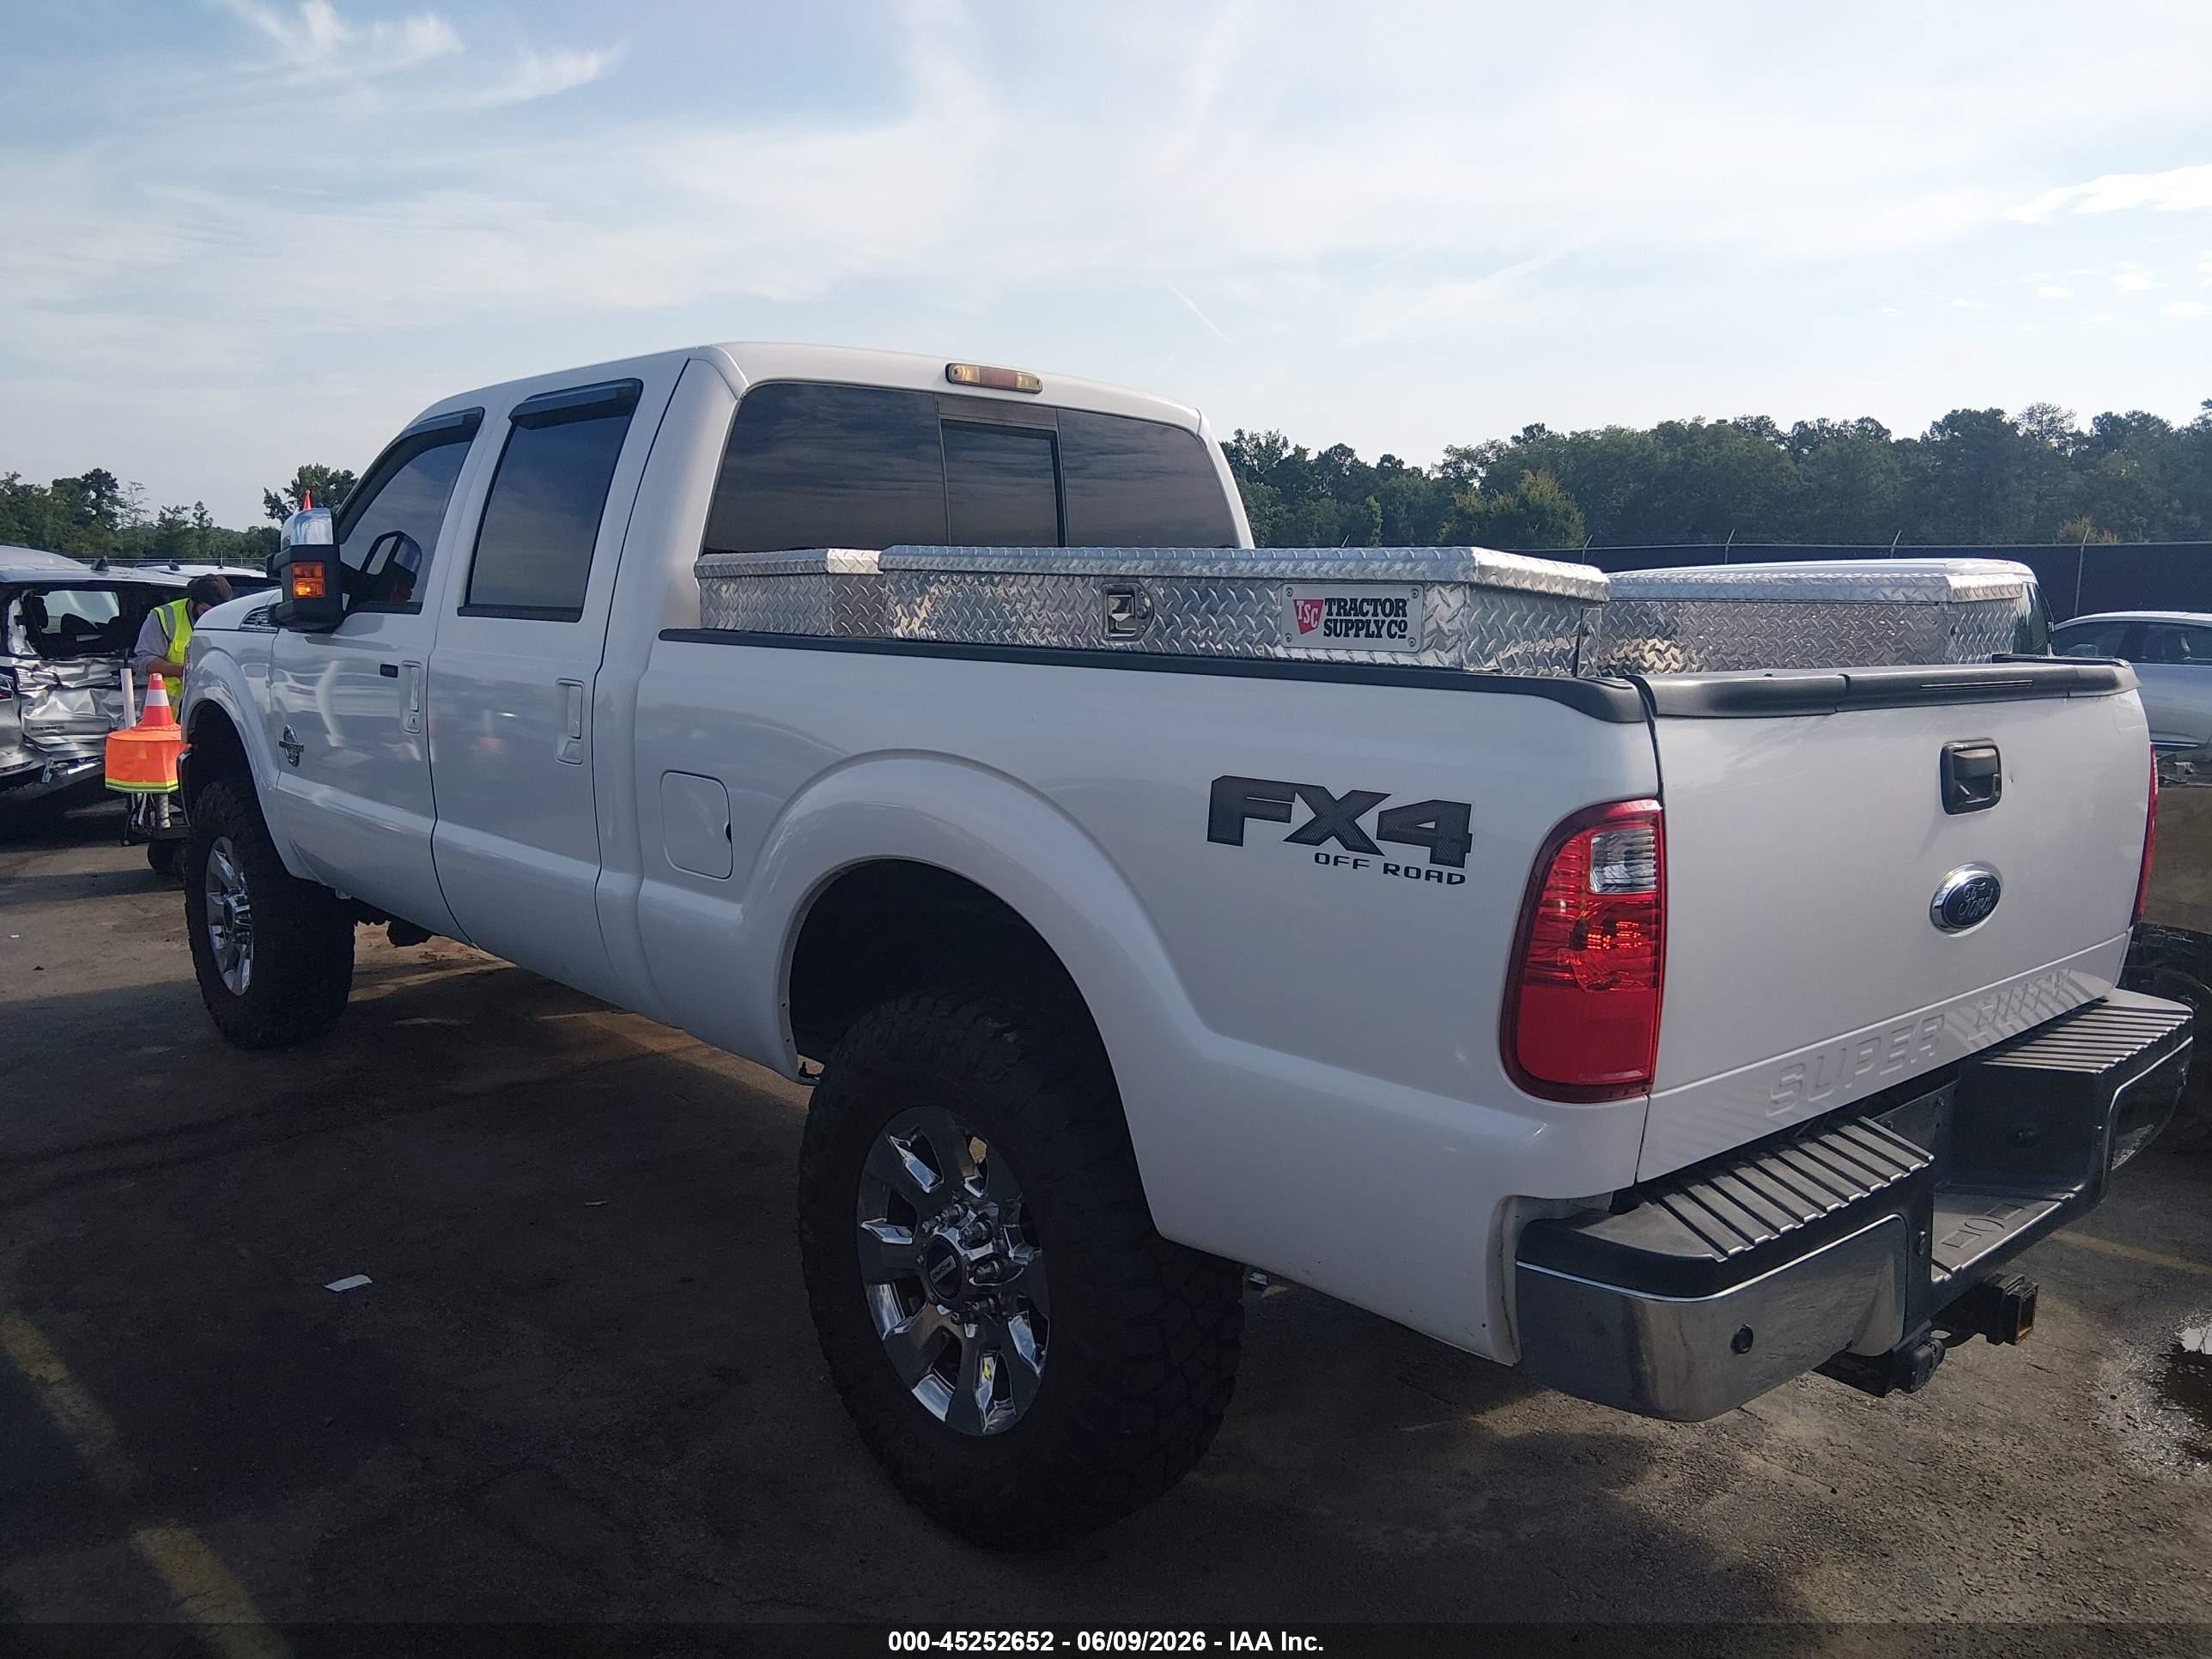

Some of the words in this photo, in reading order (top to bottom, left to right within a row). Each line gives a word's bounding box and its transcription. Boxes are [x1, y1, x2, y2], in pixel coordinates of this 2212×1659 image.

[1296, 600, 1319, 629] TSC
[1324, 598, 1407, 617] TRACTOR
[1323, 618, 1387, 639] SUPPLY
[1207, 775, 1472, 869] FX4
[1314, 852, 1370, 870] OFF
[1382, 862, 1466, 885] ROAD
[1958, 881, 1994, 921] Ford
[1765, 1012, 1945, 1117] SUPER
